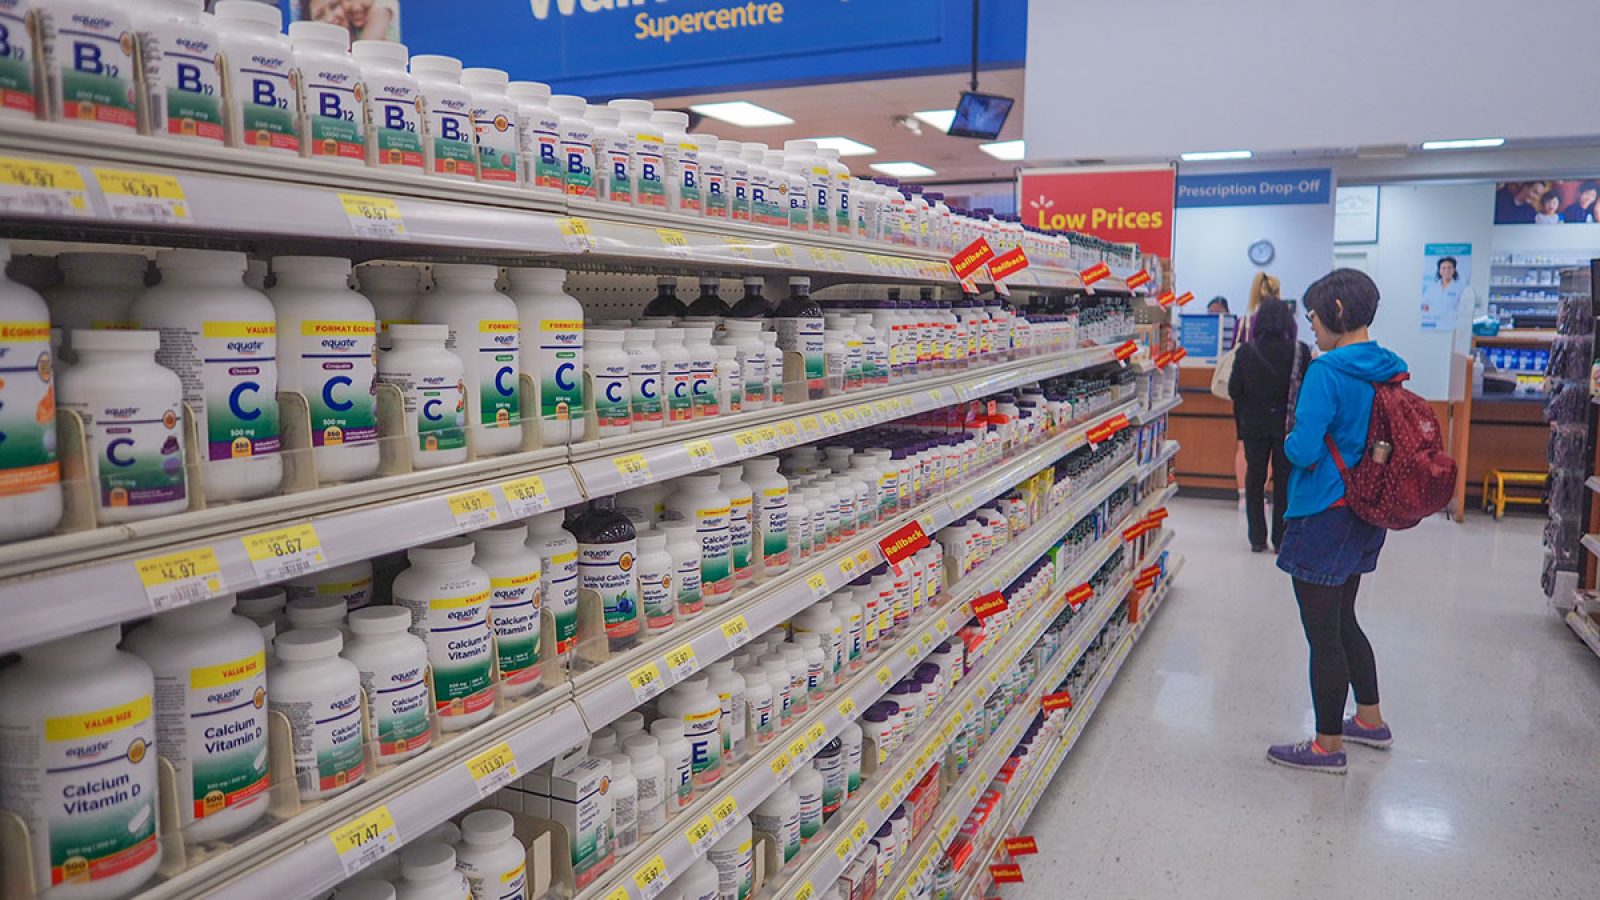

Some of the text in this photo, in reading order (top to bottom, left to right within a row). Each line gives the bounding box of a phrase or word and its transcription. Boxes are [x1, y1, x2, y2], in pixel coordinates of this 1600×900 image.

[634, 1, 785, 43] Supercentre
[1178, 178, 1321, 199] Prescription Drop-Off
[1038, 206, 1164, 232] Low Prices
[315, 324, 351, 333] FORMAT
[227, 340, 262, 353] equate
[321, 338, 357, 352] equate
[495, 366, 514, 397] C
[555, 362, 576, 391] C
[322, 375, 354, 412] C
[605, 381, 622, 403] C
[640, 378, 656, 399] C
[674, 381, 687, 399] C
[693, 379, 708, 396] C
[229, 381, 262, 421] C
[423, 399, 443, 421] C
[106, 437, 136, 468] C
[885, 530, 924, 556] Rollback
[583, 549, 612, 559] equate
[494, 588, 527, 601] equate
[447, 606, 481, 622] equate
[494, 614, 528, 627] Calcium
[494, 624, 527, 636] Vitamin
[447, 637, 482, 651] Calcium
[447, 647, 481, 661] Vitamin
[391, 667, 420, 683] equate
[207, 688, 243, 704] equate
[391, 694, 419, 708] Calcium
[391, 702, 418, 715] Vitamin
[83, 710, 132, 731] VALUE SIZE
[204, 717, 255, 740] Calcium
[204, 726, 262, 754] Vitamin D
[691, 740, 709, 764] E
[62, 773, 129, 798] Calcium
[63, 783, 141, 816] Vitamin D
[349, 823, 380, 847] $7.47
